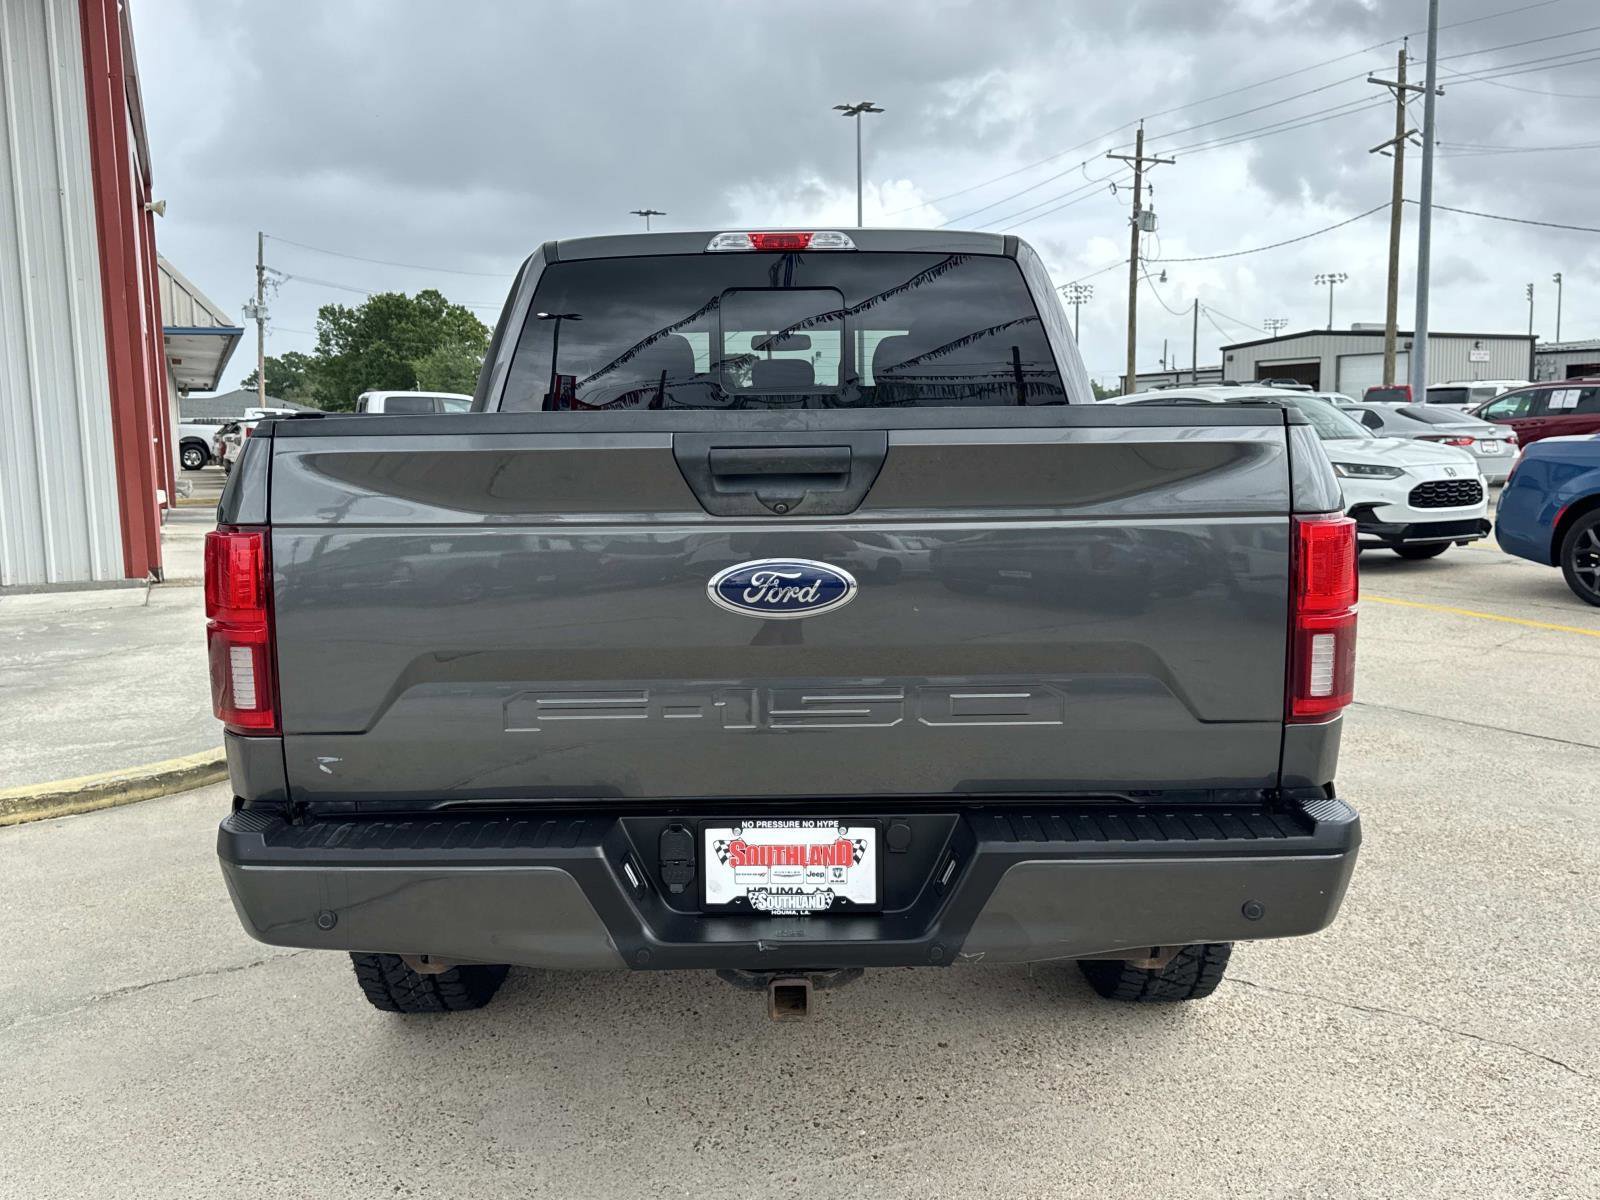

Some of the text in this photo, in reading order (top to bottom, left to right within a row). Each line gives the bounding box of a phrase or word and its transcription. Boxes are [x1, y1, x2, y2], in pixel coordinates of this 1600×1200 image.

[743, 571, 822, 604] Ford
[503, 684, 1066, 733] F-150
[741, 820, 839, 828] NO PRESSURE NO HYPE
[729, 839, 854, 868] SOUTHLAND
[806, 871, 825, 879] Jeep
[757, 893, 826, 910] SOUTHLAND
